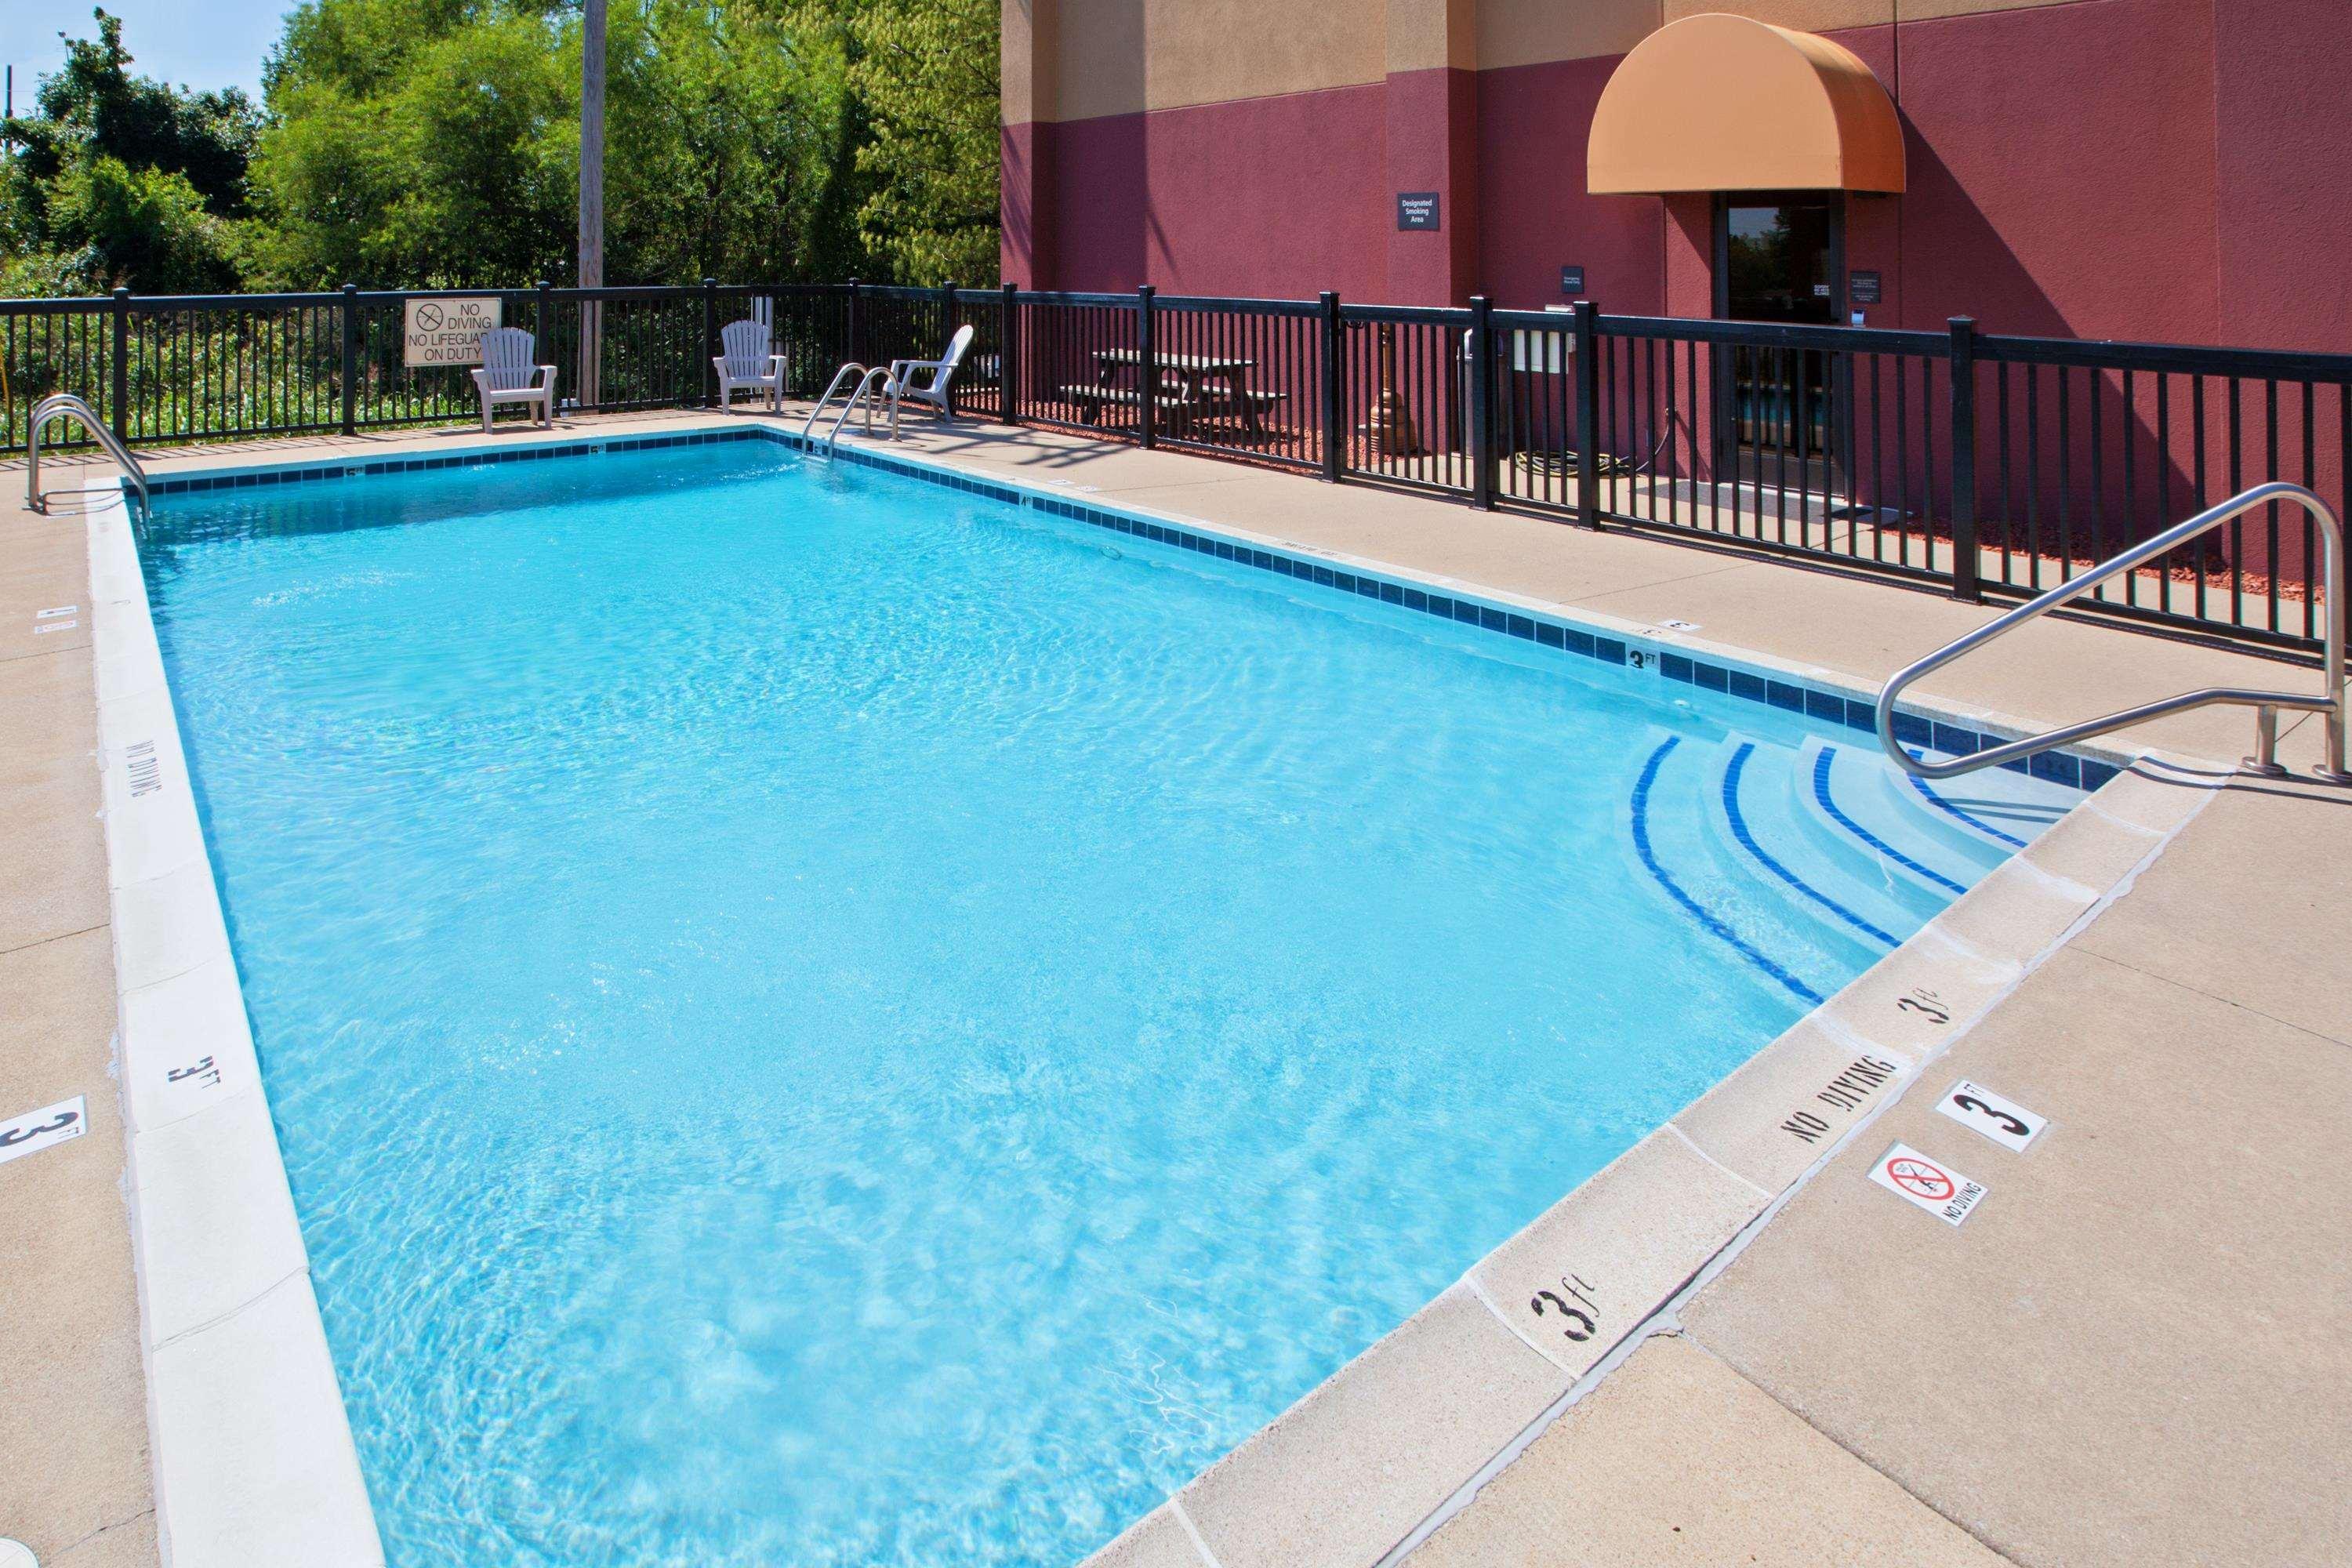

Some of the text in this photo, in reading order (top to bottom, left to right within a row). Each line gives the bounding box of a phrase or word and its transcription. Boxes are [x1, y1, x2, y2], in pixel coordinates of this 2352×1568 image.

[1402, 198, 1432, 208] Designated
[448, 316, 492, 329] DIVING
[460, 303, 480, 316] NO
[408, 332, 488, 347] NO LIFEGUA
[424, 347, 481, 361] ON DUTY
[1645, 653, 1656, 664] FT
[1897, 998, 1949, 1024] 3
[168, 1055, 214, 1083] 3
[1780, 1055, 1896, 1144] NO DIVING
[1953, 1094, 2031, 1136] 3
[0, 1112, 79, 1148] 3
[1942, 1181, 1982, 1221] NO DIVING
[1530, 1290, 1596, 1342] 3
